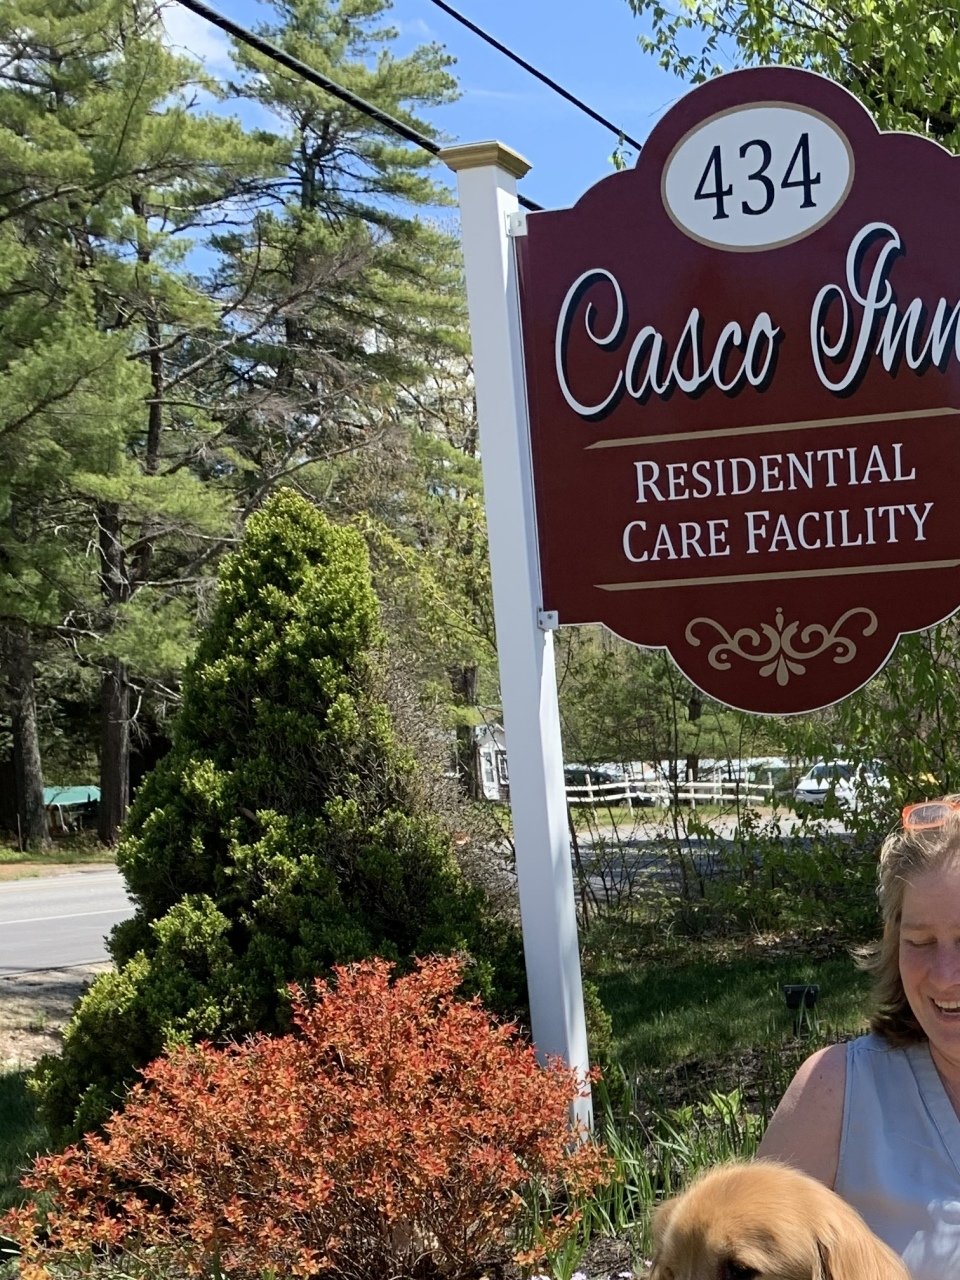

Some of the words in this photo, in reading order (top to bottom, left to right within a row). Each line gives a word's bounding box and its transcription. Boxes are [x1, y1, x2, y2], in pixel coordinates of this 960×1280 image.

[693, 132, 822, 221] 434
[554, 267, 782, 418] Casco
[633, 443, 916, 504] RESIDENTIAL
[622, 519, 731, 564] CARE
[745, 502, 935, 556] FACILITY
